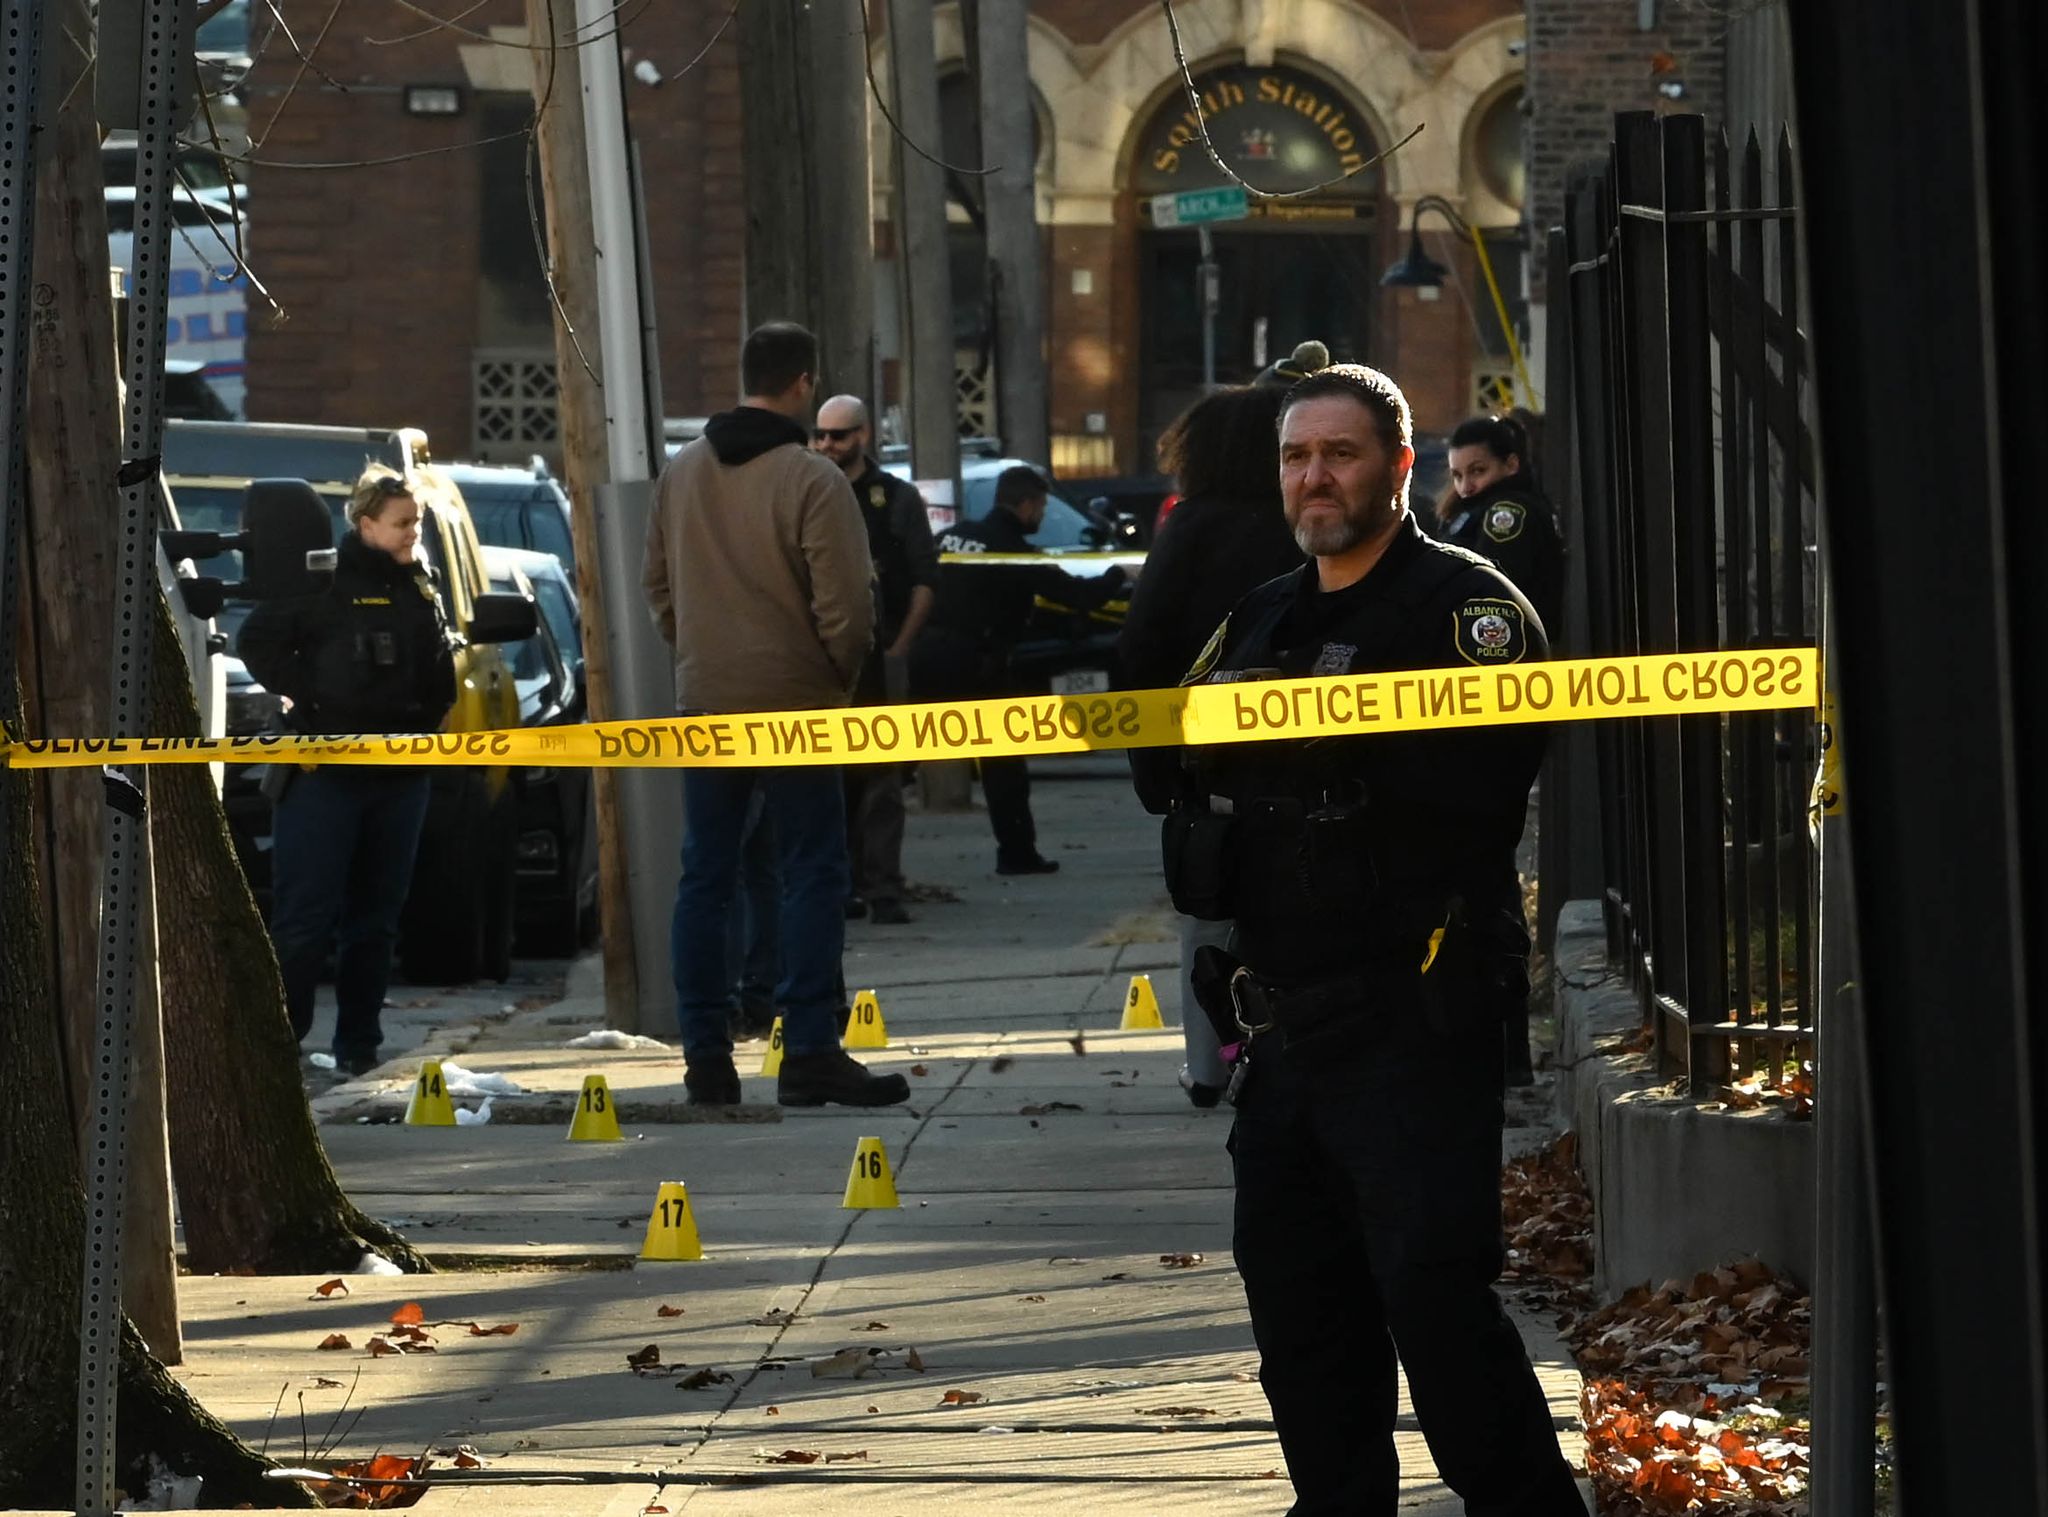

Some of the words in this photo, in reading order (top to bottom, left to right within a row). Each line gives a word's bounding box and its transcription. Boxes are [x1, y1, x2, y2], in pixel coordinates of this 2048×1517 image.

[1153, 80, 1244, 173] South
[1257, 77, 1361, 175] Station
[1476, 647, 1509, 657] POLICE
[1130, 986, 1139, 1007] 9
[855, 1004, 875, 1026] 10
[419, 1073, 442, 1099] 14
[582, 1087, 606, 1114] 13
[857, 1151, 882, 1180] 16
[659, 1199, 685, 1229] 17
